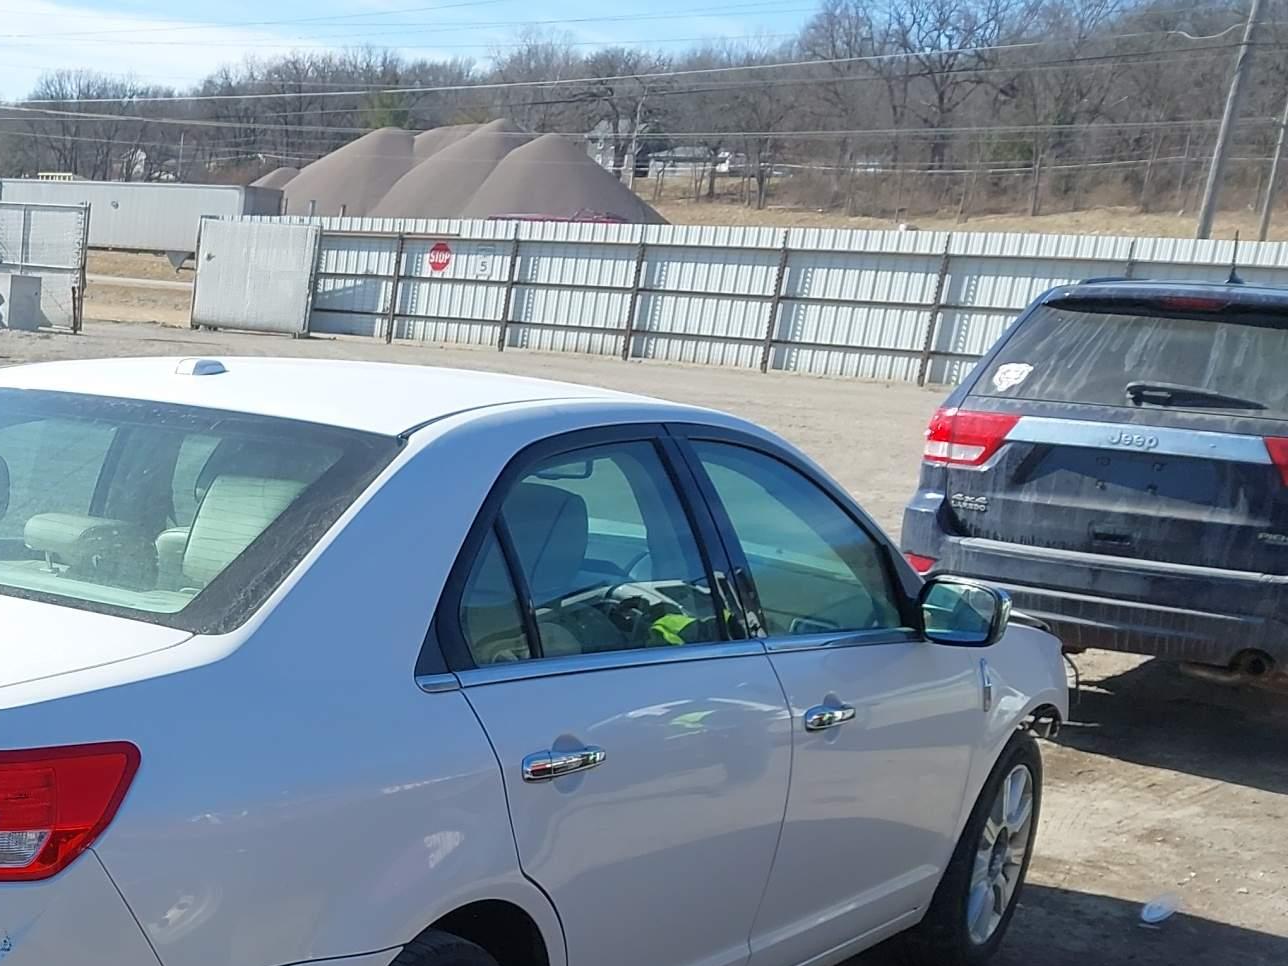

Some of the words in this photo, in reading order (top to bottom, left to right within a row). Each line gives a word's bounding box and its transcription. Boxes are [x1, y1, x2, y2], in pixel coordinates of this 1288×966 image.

[429, 250, 451, 264] STOP
[479, 260, 488, 272] 5
[1108, 430, 1160, 451] Jeep
